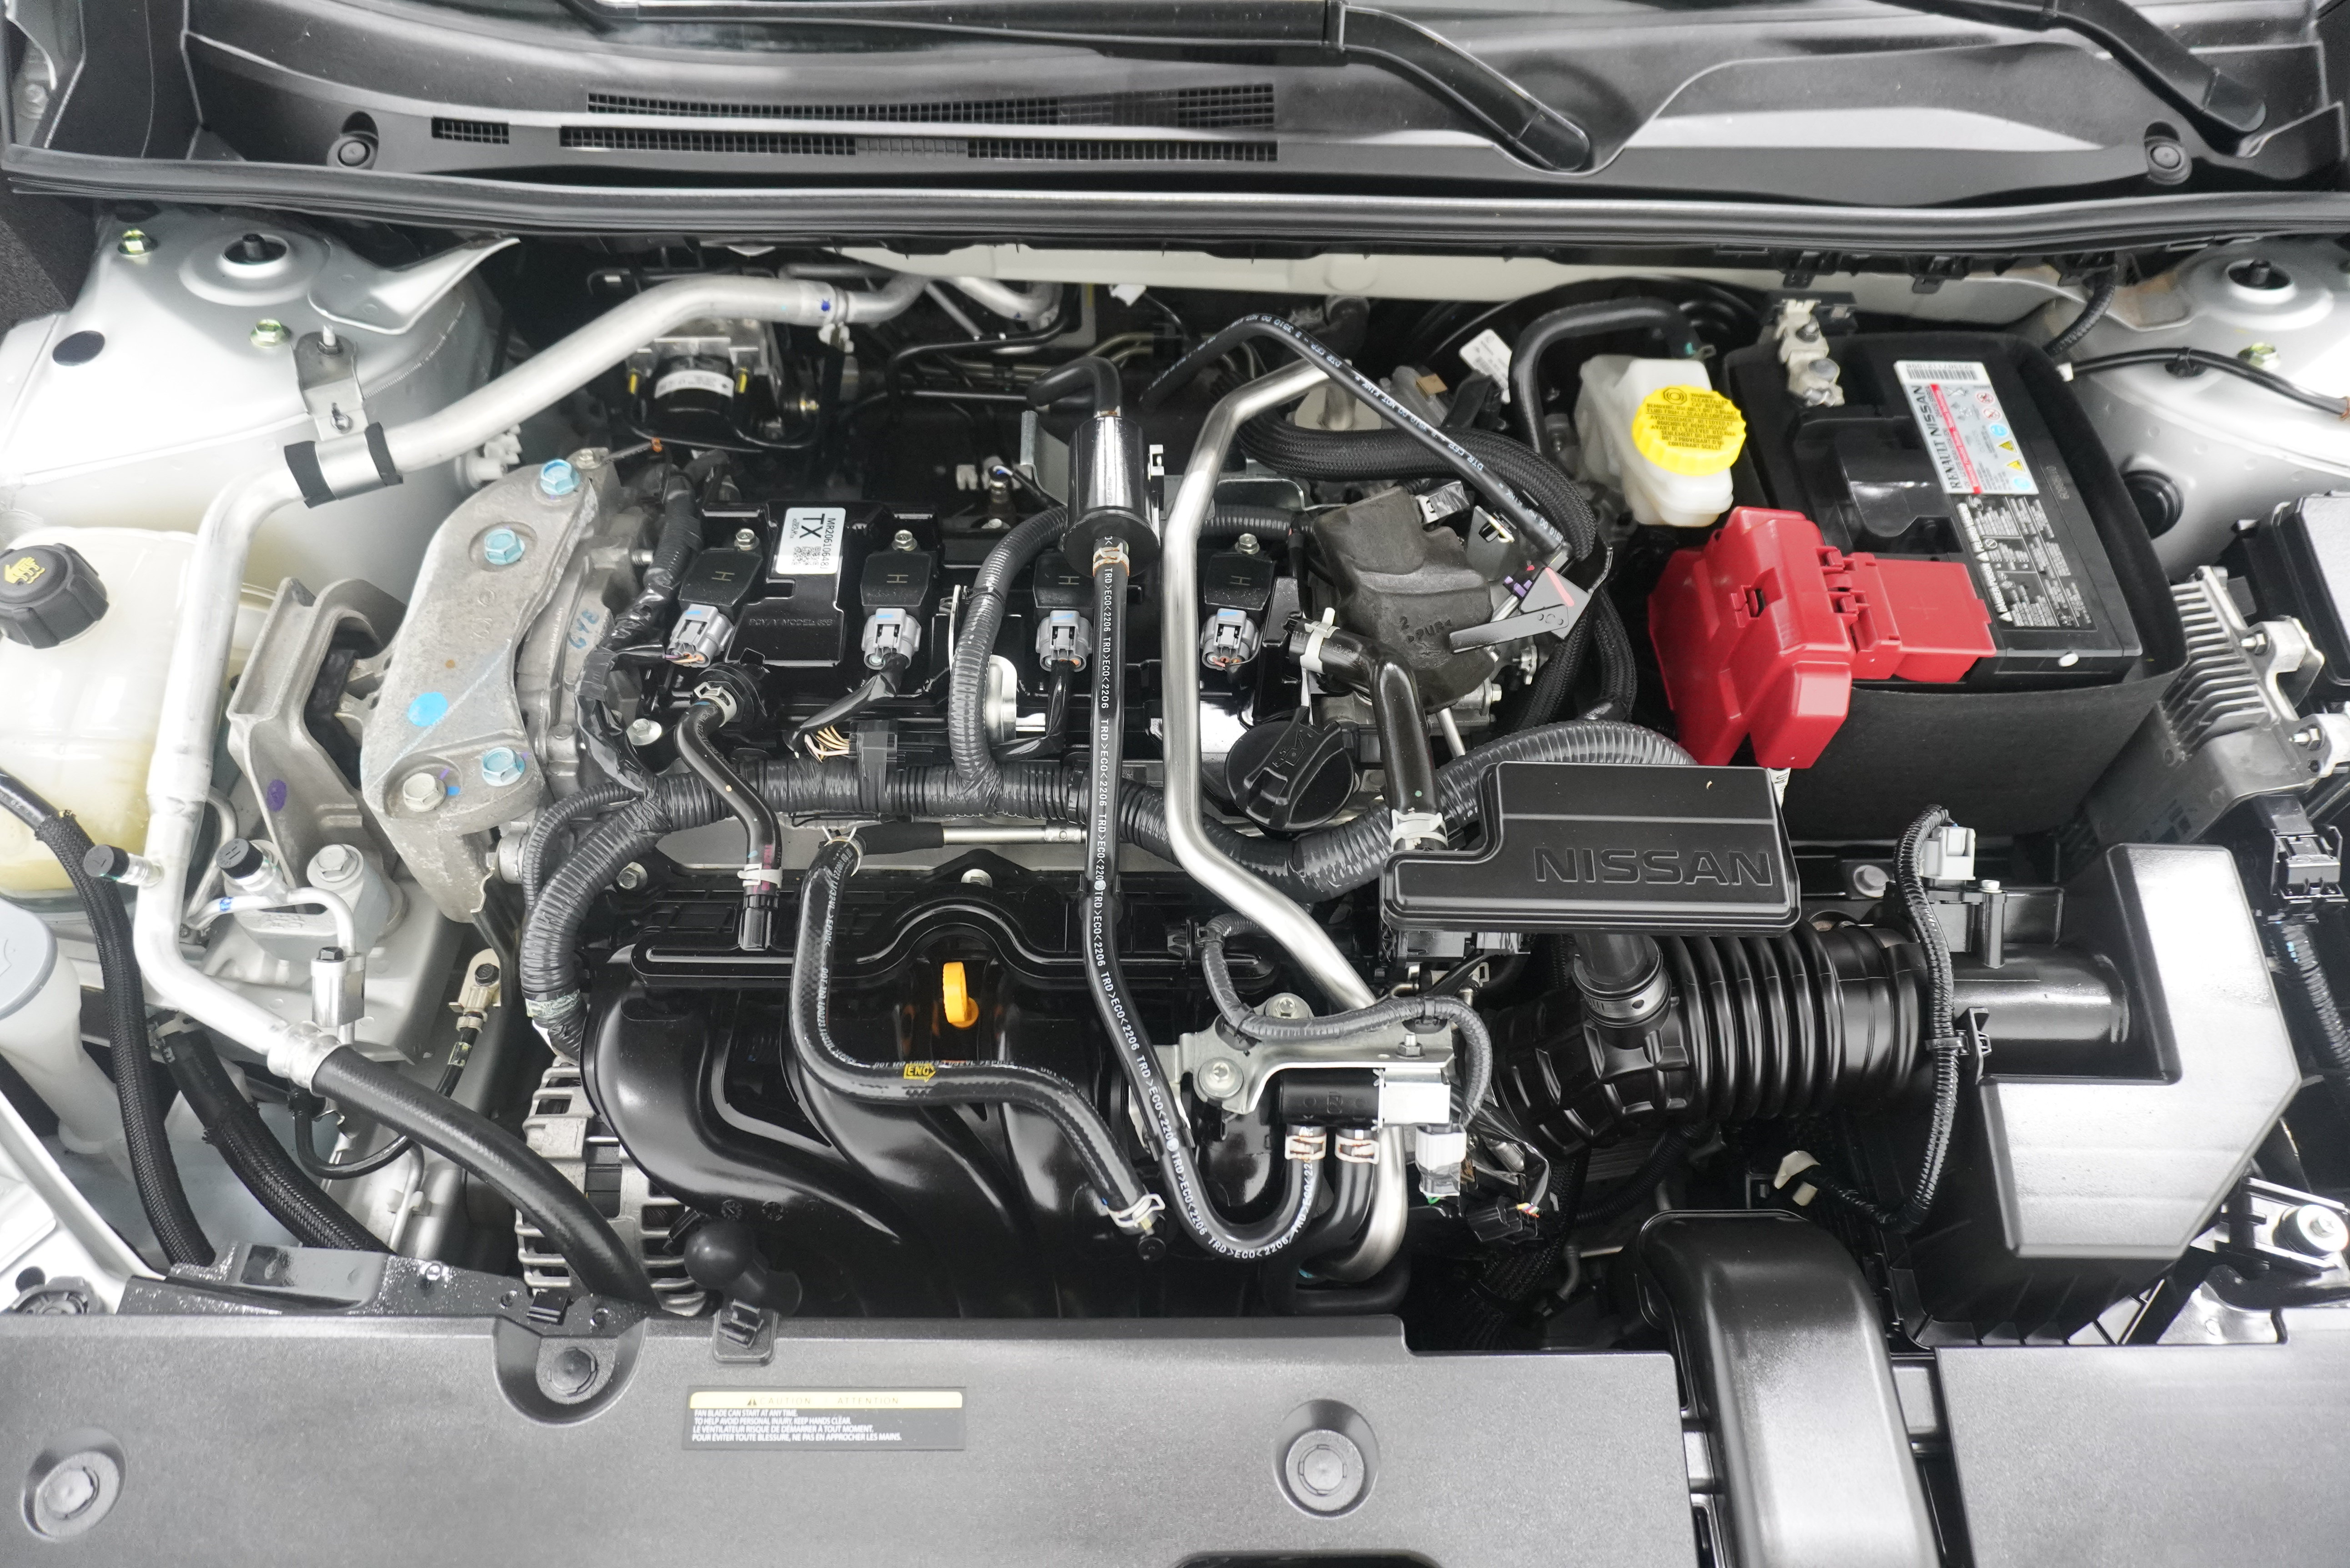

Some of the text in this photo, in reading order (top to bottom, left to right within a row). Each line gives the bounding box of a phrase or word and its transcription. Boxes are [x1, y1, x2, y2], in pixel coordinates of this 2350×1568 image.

[1912, 386, 1941, 437] NISSAN
[1933, 440, 1962, 489] RENAULT
[799, 513, 825, 538] TX
[1534, 846, 1773, 886] NISSAN
[907, 1067, 930, 1076] ENG
[694, 1417, 703, 1425] TO
[703, 1417, 718, 1425] HELP
[719, 1417, 739, 1425] AVOID
[739, 1417, 770, 1425] PERSONAL
[793, 1417, 808, 1425] KEEP
[809, 1417, 830, 1425] HANDS
[692, 1433, 711, 1441] POUR
[735, 1433, 757, 1441] TOUTE
[792, 1433, 801, 1441] NE
[802, 1433, 815, 1441] PAS
[815, 1433, 825, 1441] EN
[826, 1433, 865, 1441] APPROCHER
[866, 1433, 878, 1441] LES
